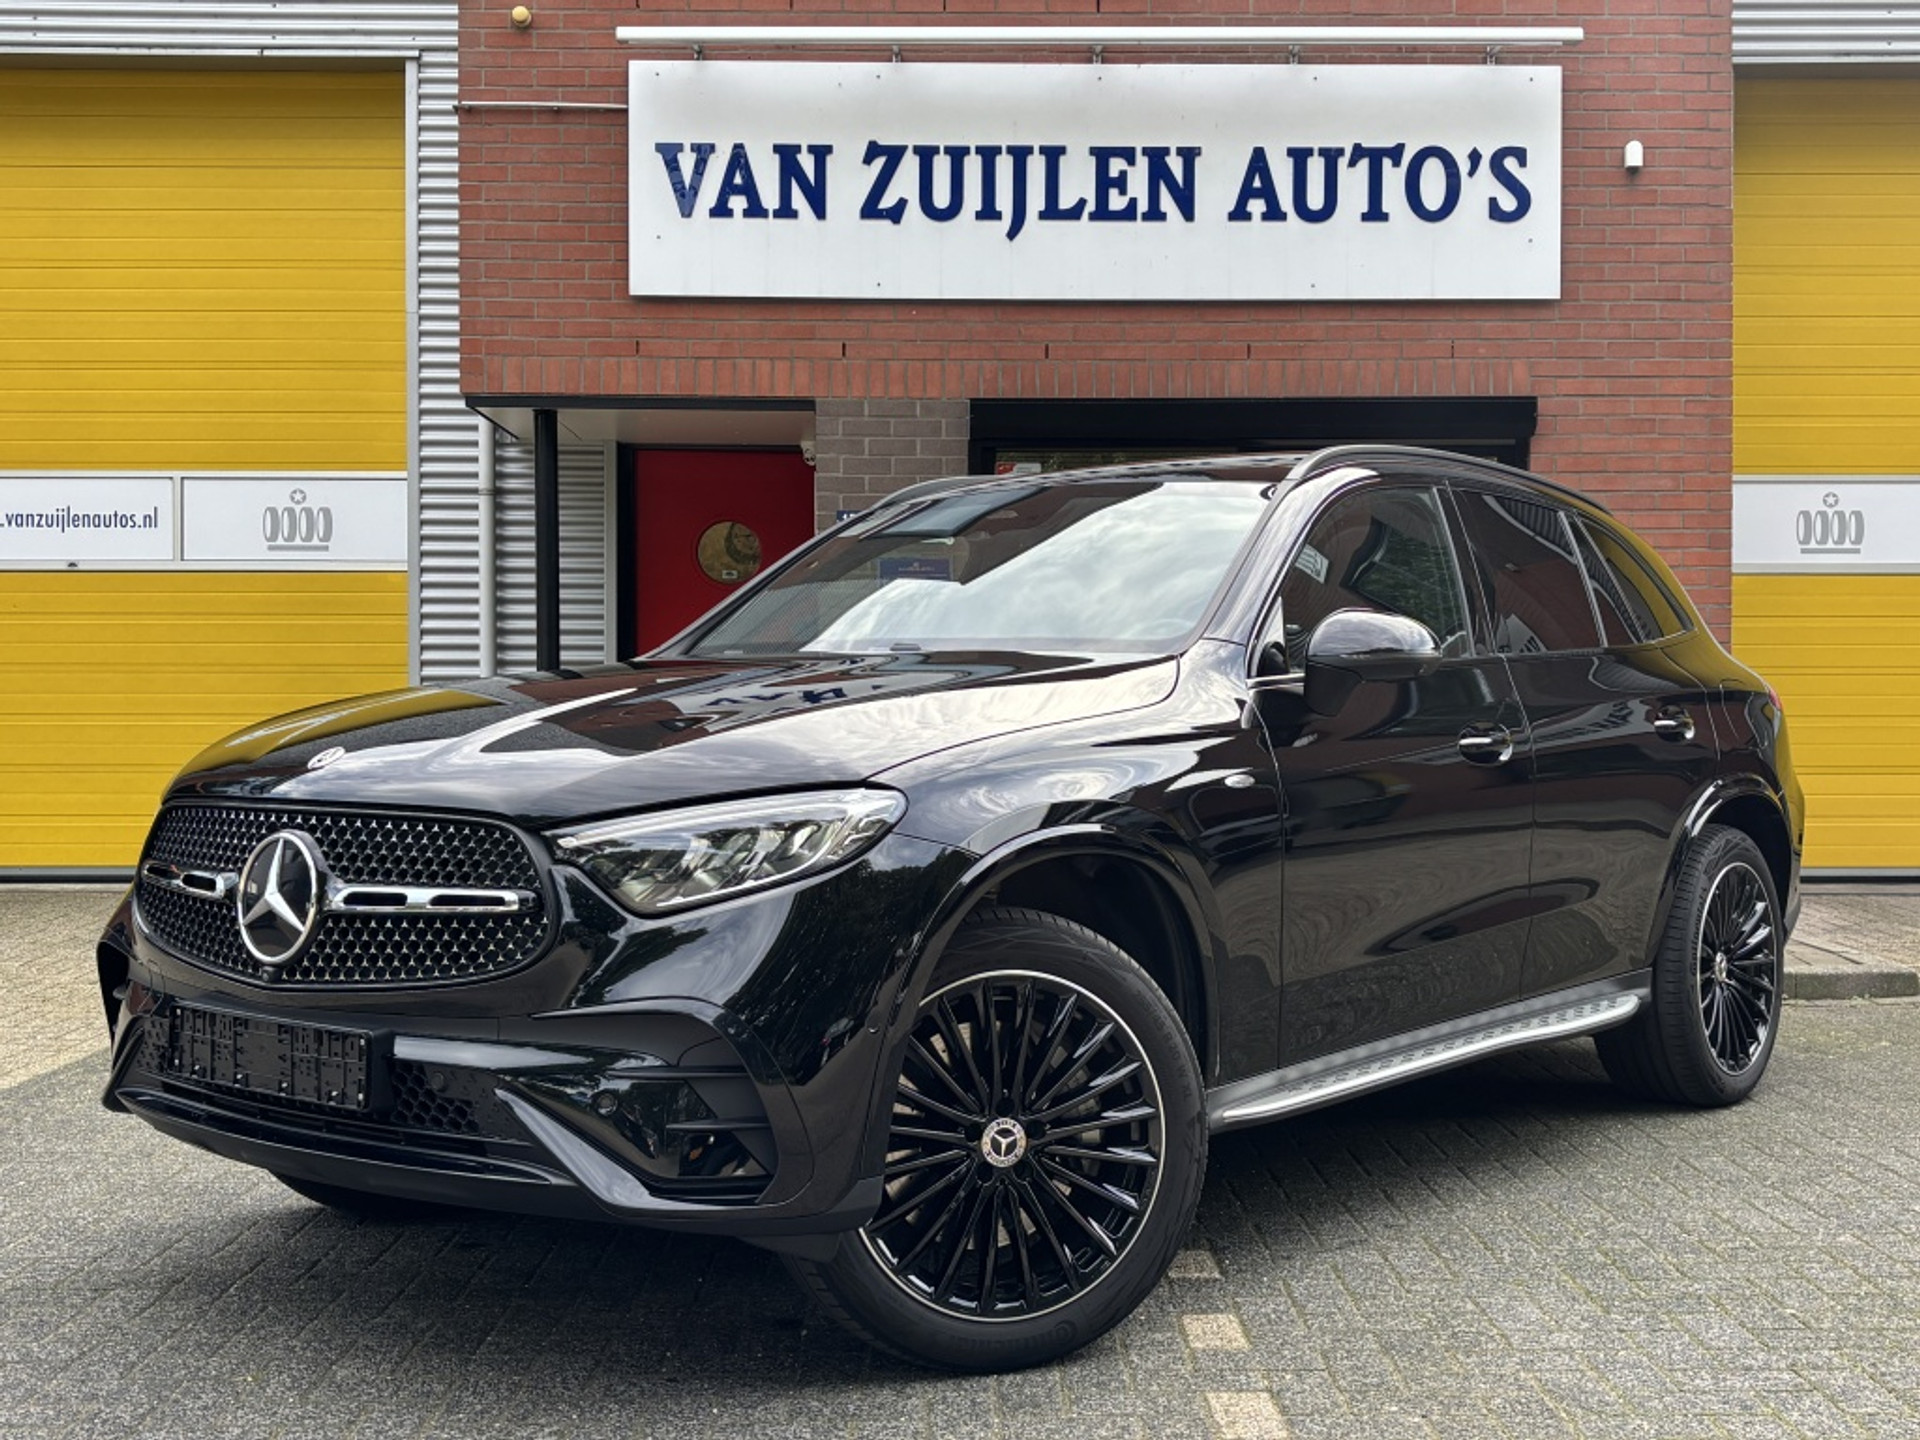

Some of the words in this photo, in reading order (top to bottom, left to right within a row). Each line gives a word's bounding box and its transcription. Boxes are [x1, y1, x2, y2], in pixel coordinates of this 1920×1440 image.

[654, 142, 834, 221] VAN
[859, 139, 1202, 242] ZUIJLEN
[1227, 142, 1532, 224] AUTO'S
